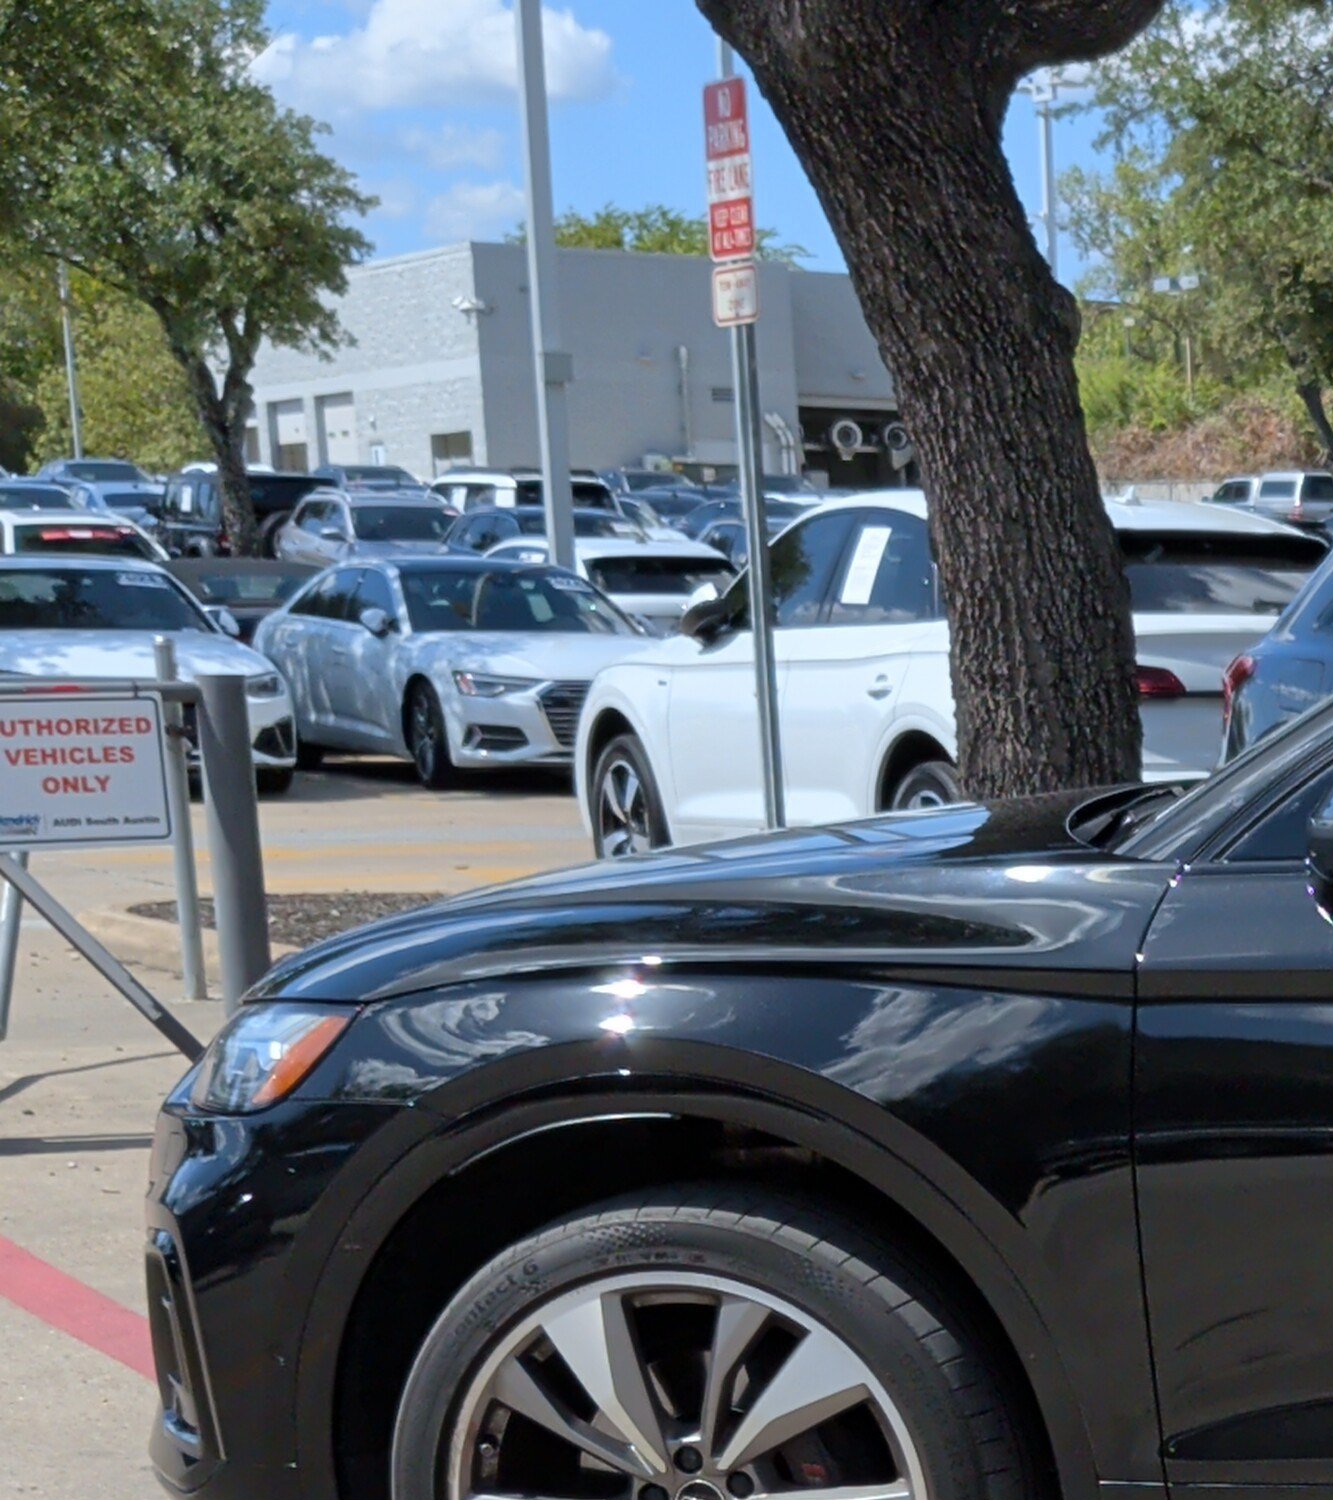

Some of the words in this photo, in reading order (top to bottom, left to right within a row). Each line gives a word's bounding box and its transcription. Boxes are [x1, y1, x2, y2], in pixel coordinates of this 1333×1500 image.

[0, 717, 152, 737] UTHORIZED
[5, 746, 135, 766] VEHICLES
[42, 775, 111, 794] ONLY
